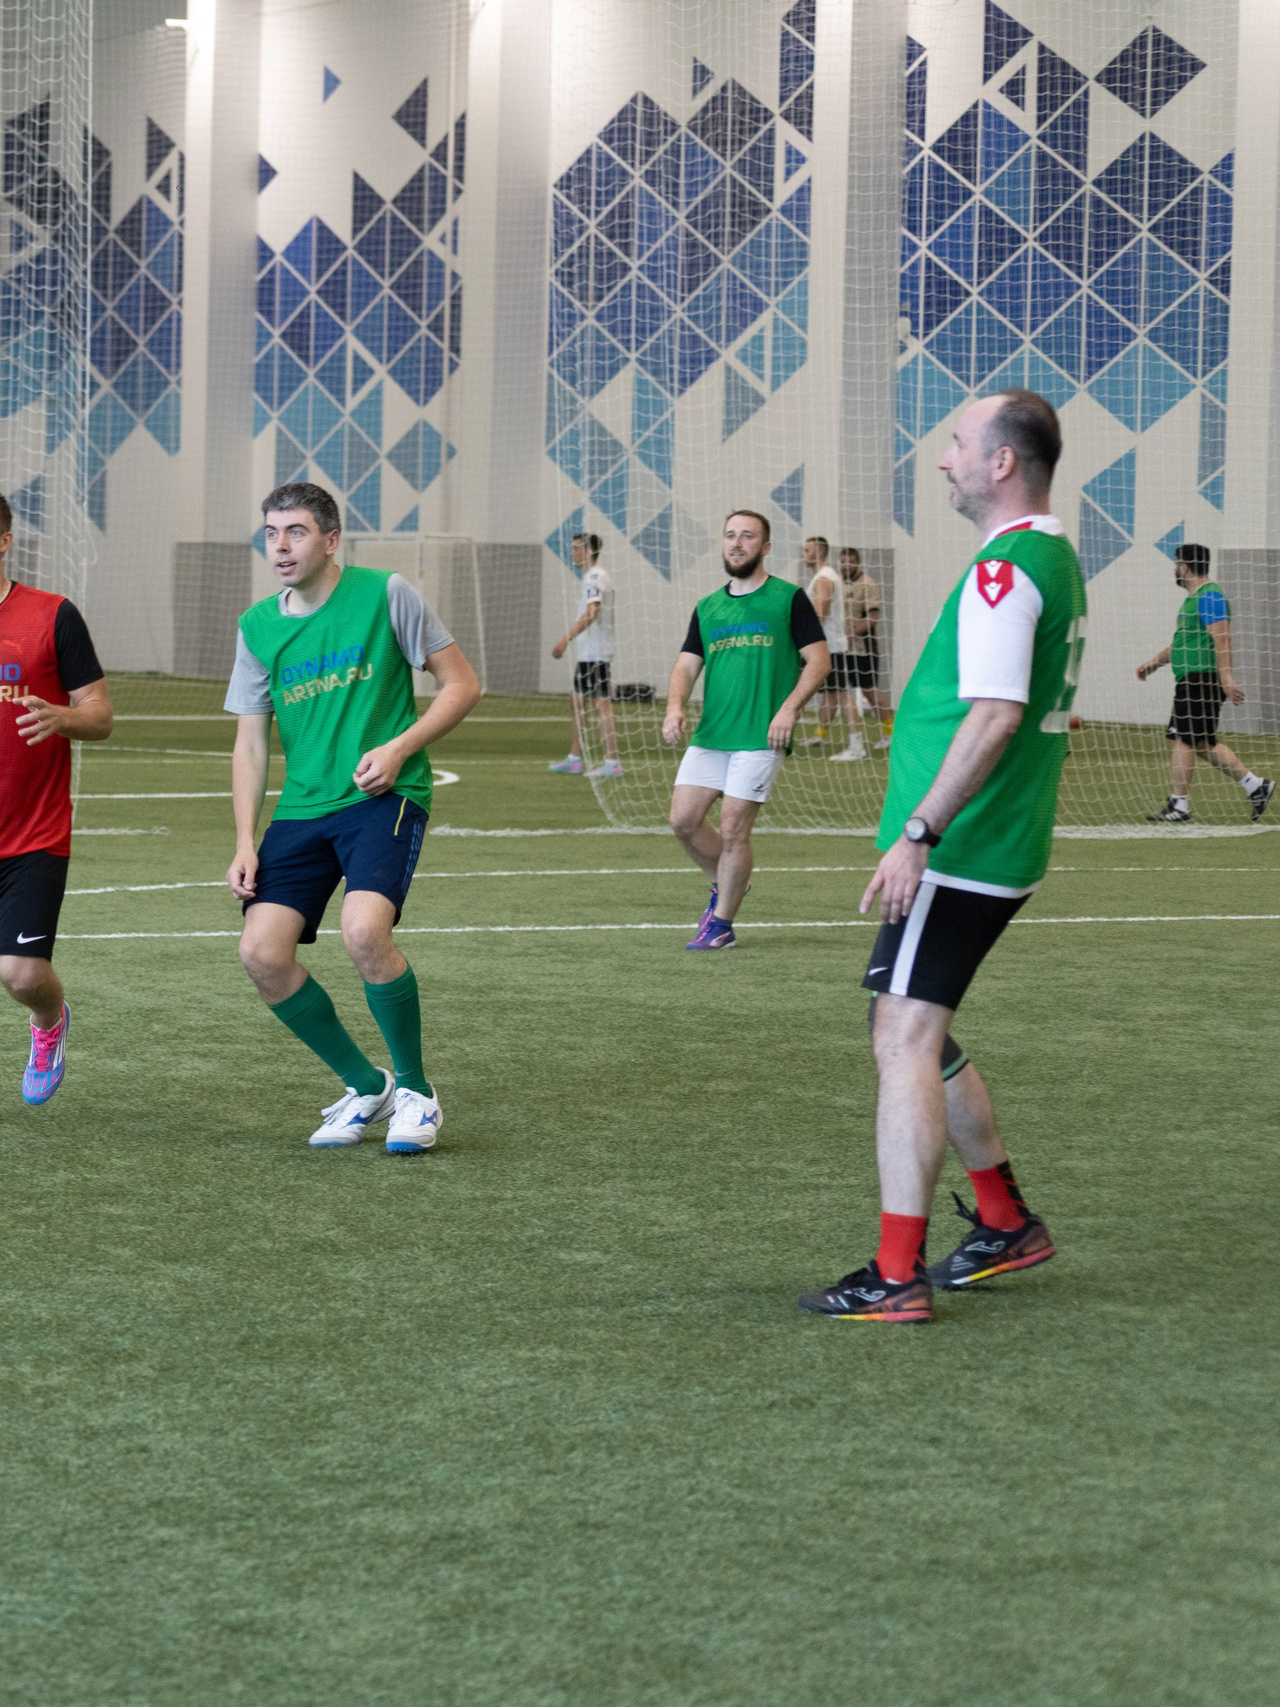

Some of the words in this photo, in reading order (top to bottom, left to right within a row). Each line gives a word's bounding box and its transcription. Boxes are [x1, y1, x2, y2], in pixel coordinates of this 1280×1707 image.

[710, 621, 769, 639] DYNAMO
[281, 645, 365, 685] DYNAMO
[282, 663, 373, 706] ARENA.RU
